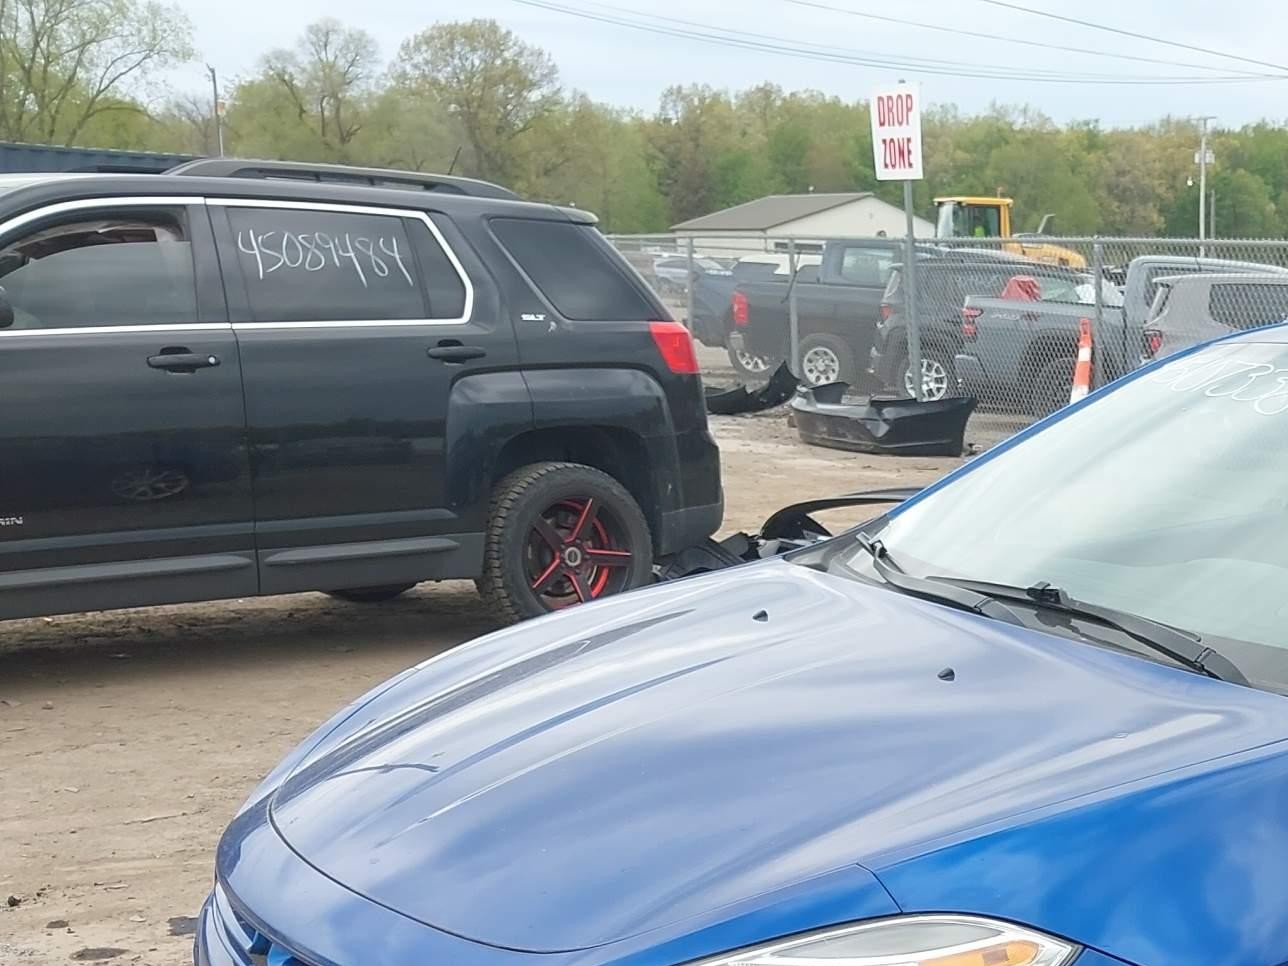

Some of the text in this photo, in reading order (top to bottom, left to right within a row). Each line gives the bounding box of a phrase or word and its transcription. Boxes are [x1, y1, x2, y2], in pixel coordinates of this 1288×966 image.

[877, 94, 913, 127] DROP
[882, 136, 913, 169] ZONE
[238, 229, 414, 288] 45089484
